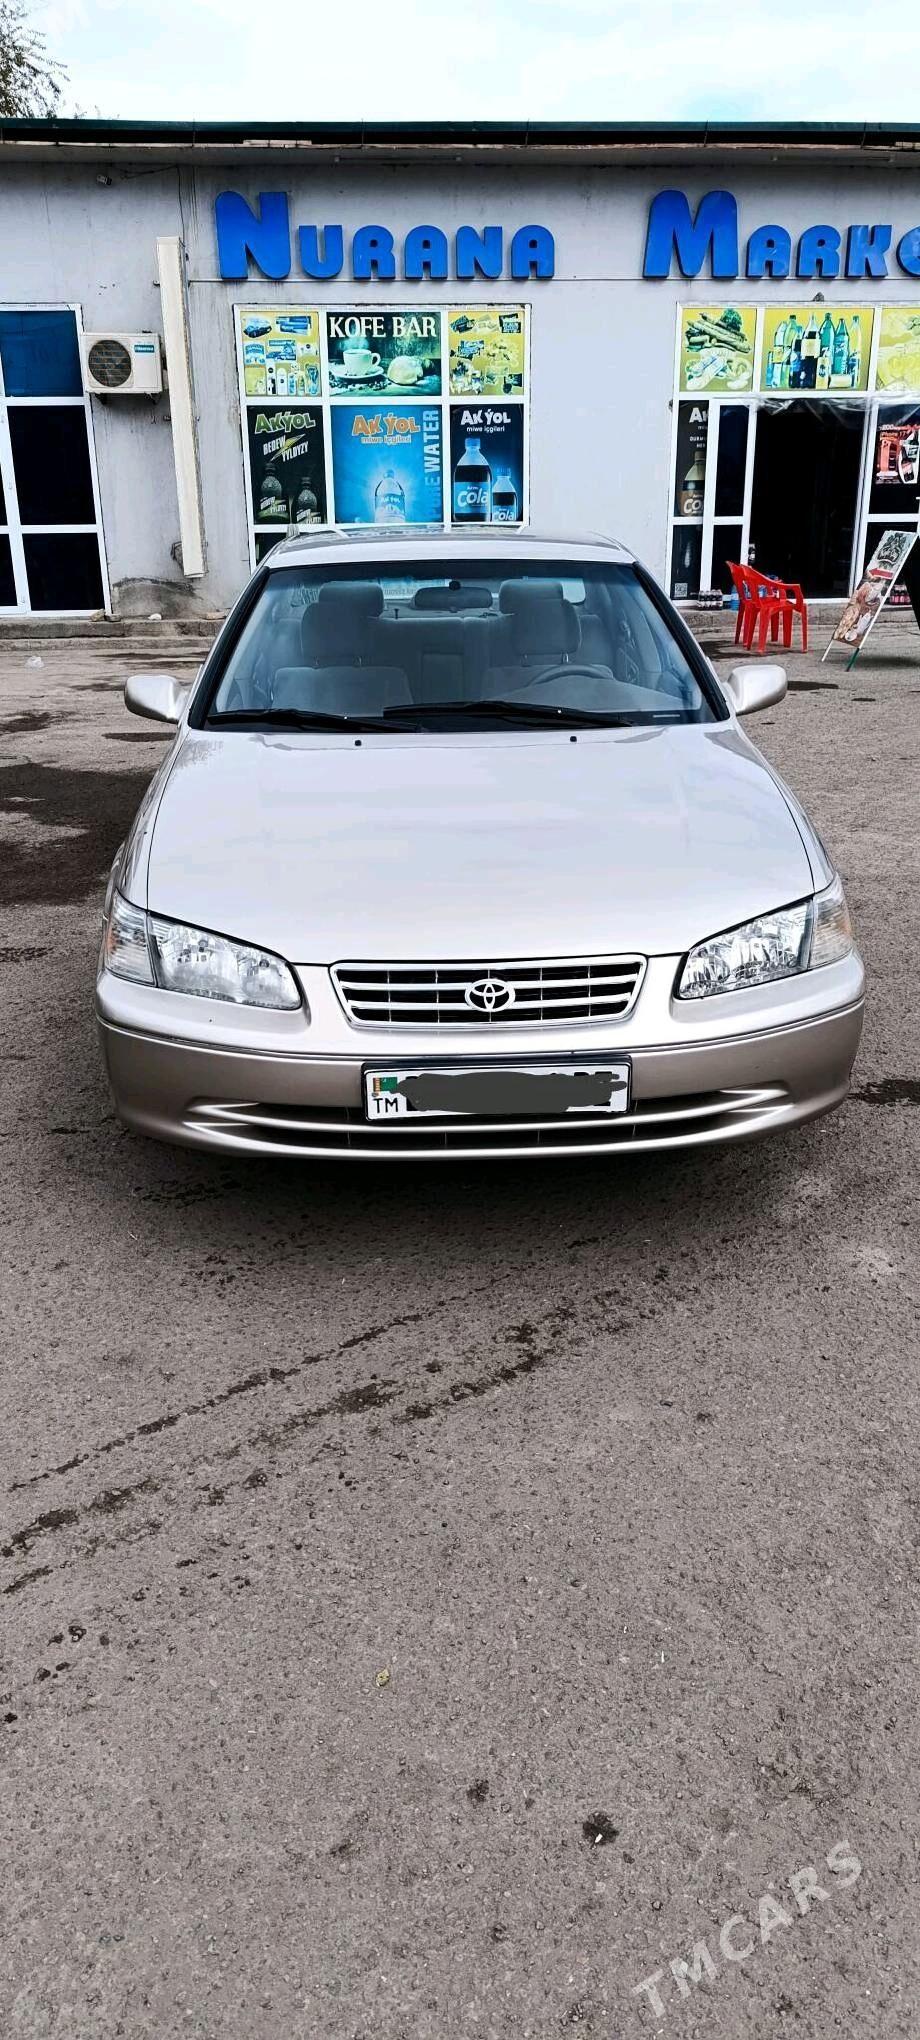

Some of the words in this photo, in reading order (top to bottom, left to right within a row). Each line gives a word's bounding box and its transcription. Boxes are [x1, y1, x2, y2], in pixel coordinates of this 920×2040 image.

[329, 316, 386, 338] KOFE
[392, 316, 437, 338] BAR
[422, 409, 441, 474] WATER
[373, 1097, 399, 1113] TM
